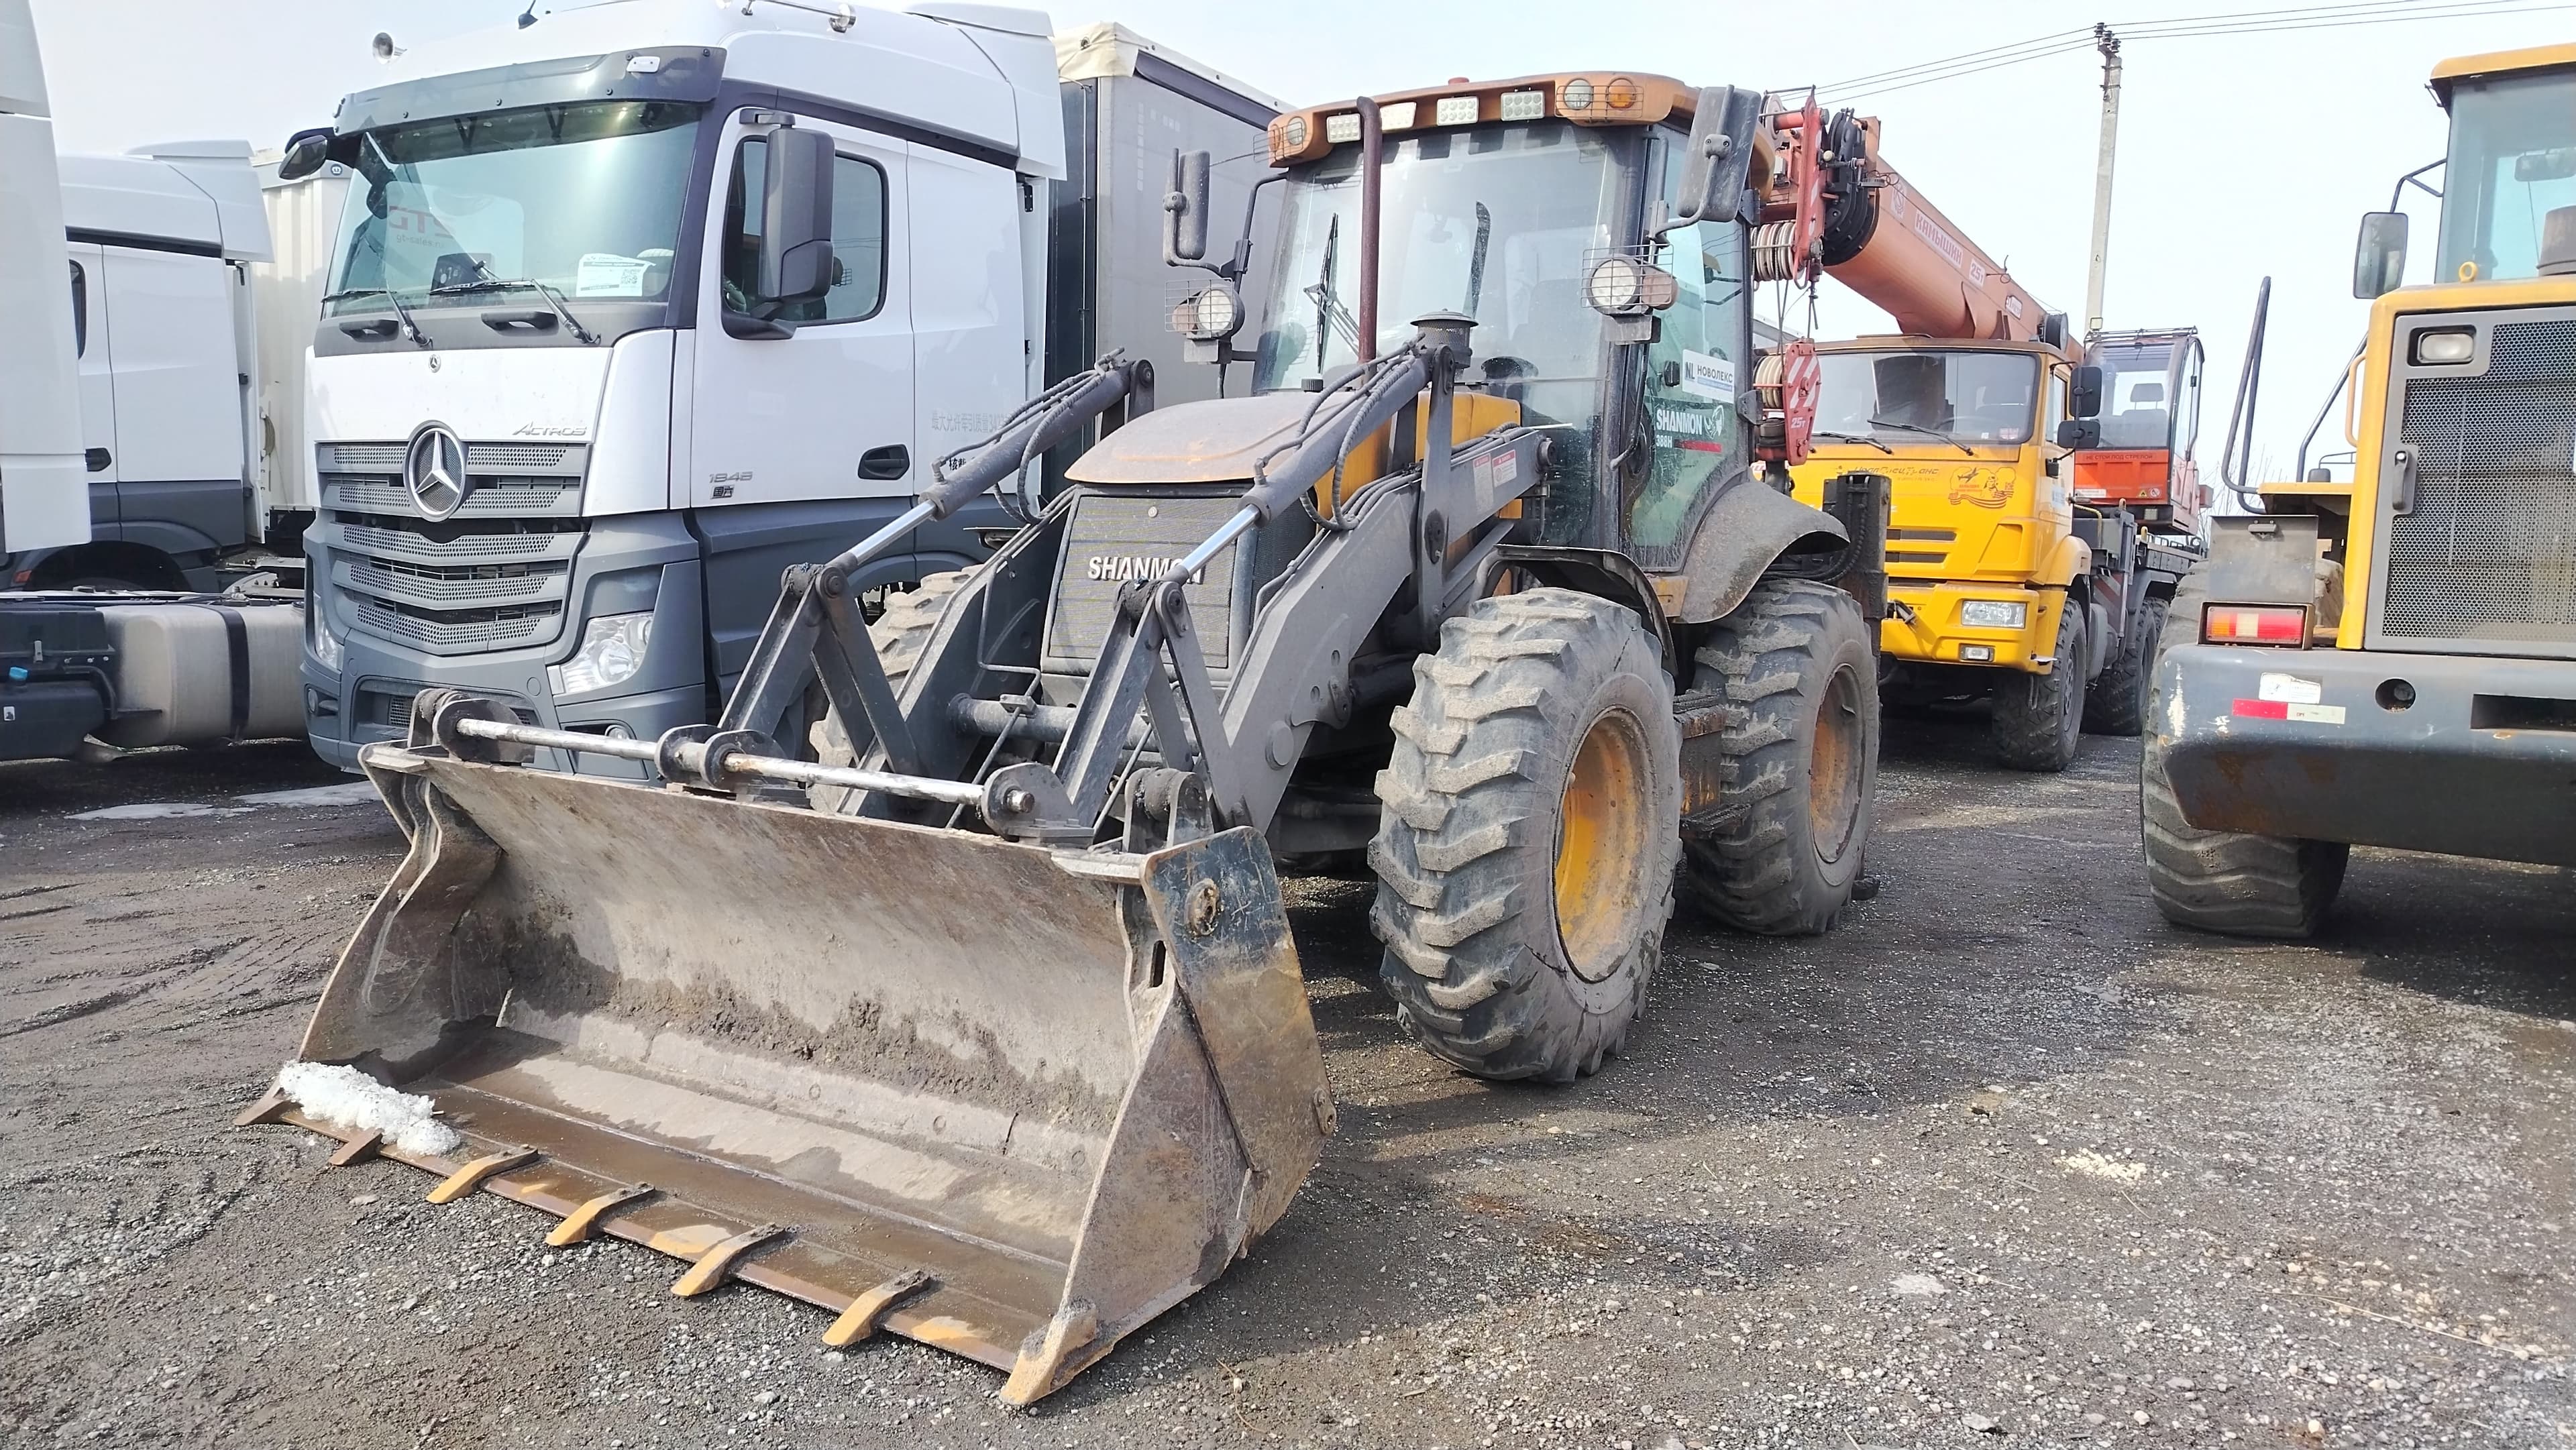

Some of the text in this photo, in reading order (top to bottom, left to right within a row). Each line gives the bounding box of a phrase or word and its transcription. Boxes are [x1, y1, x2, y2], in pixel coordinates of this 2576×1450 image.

[1916, 213, 1962, 264] КАМЫШИН
[1685, 361, 1695, 380] NL
[1697, 364, 1733, 383] НОВОЛЕКС
[1656, 408, 1703, 435] SHANMON
[709, 471, 753, 483] 1848
[1087, 556, 1205, 584] SHANMN
